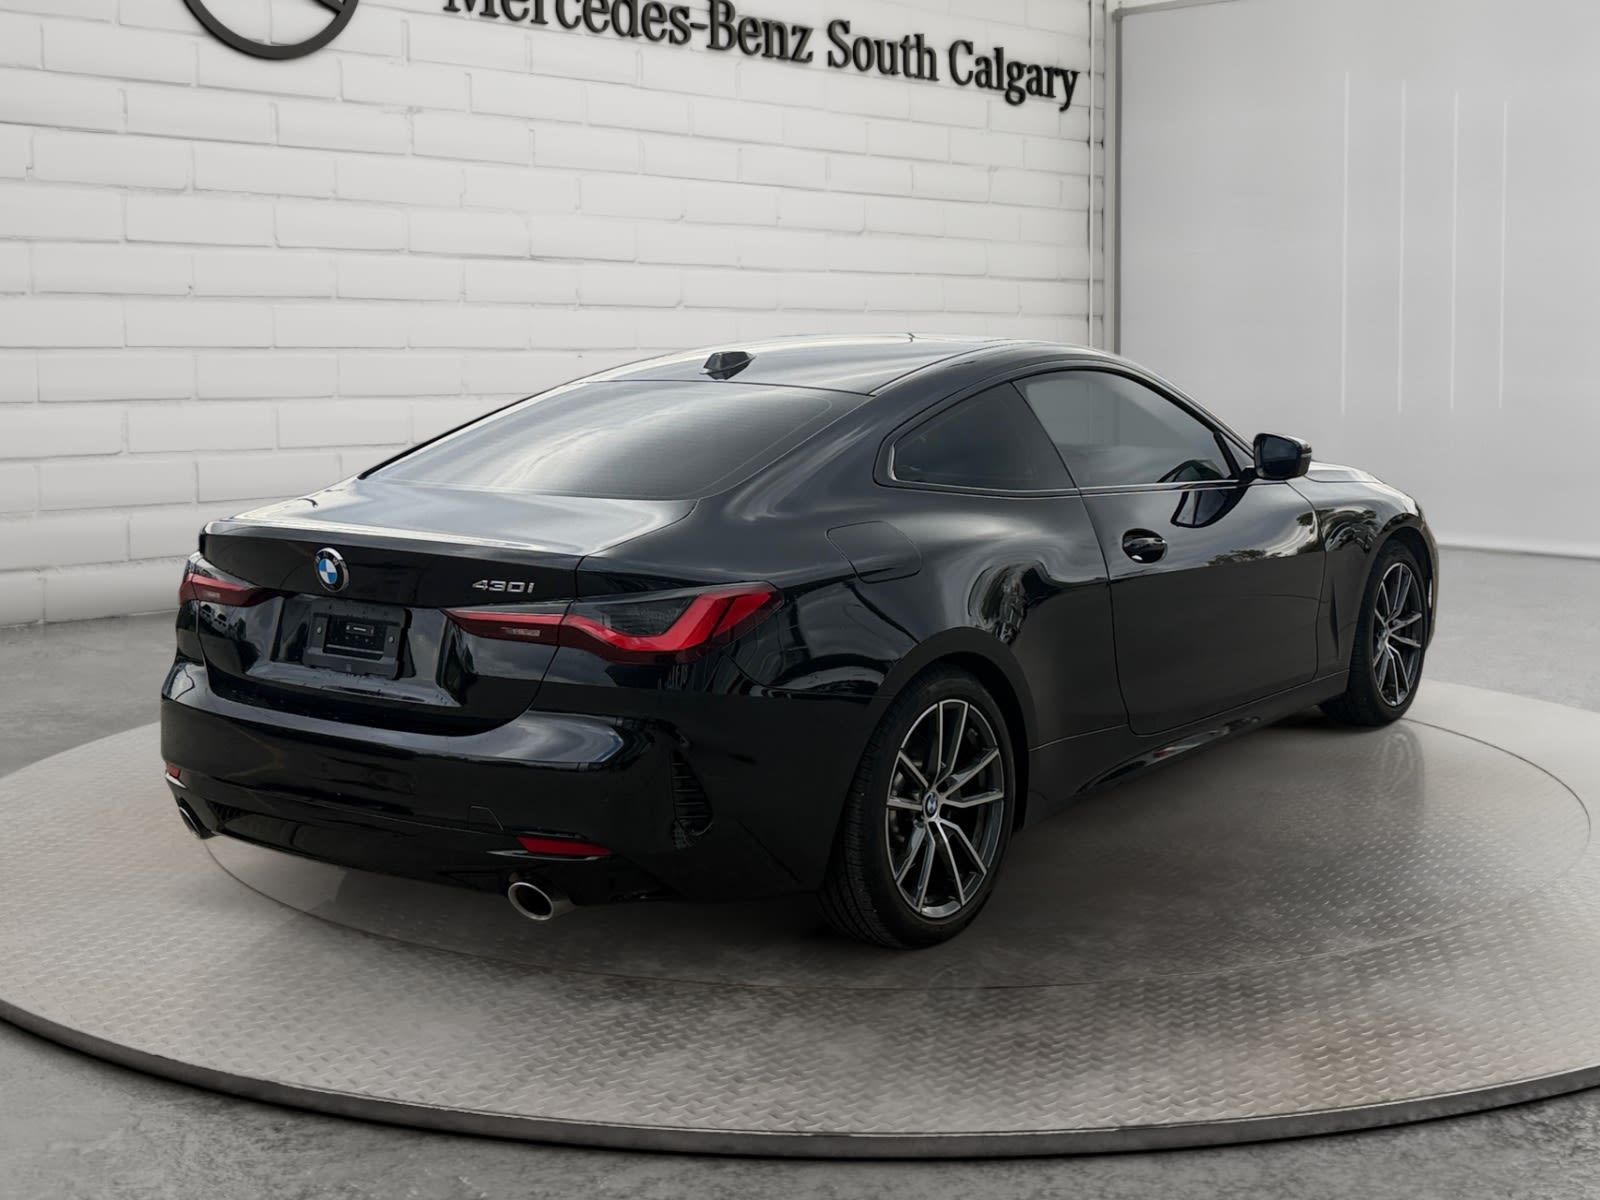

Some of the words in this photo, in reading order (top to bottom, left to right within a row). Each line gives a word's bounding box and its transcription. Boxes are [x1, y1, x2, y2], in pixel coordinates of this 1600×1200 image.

[443, 0, 814, 63] rcedes-Benz
[827, 19, 939, 81] South
[948, 40, 1080, 112] Calgary
